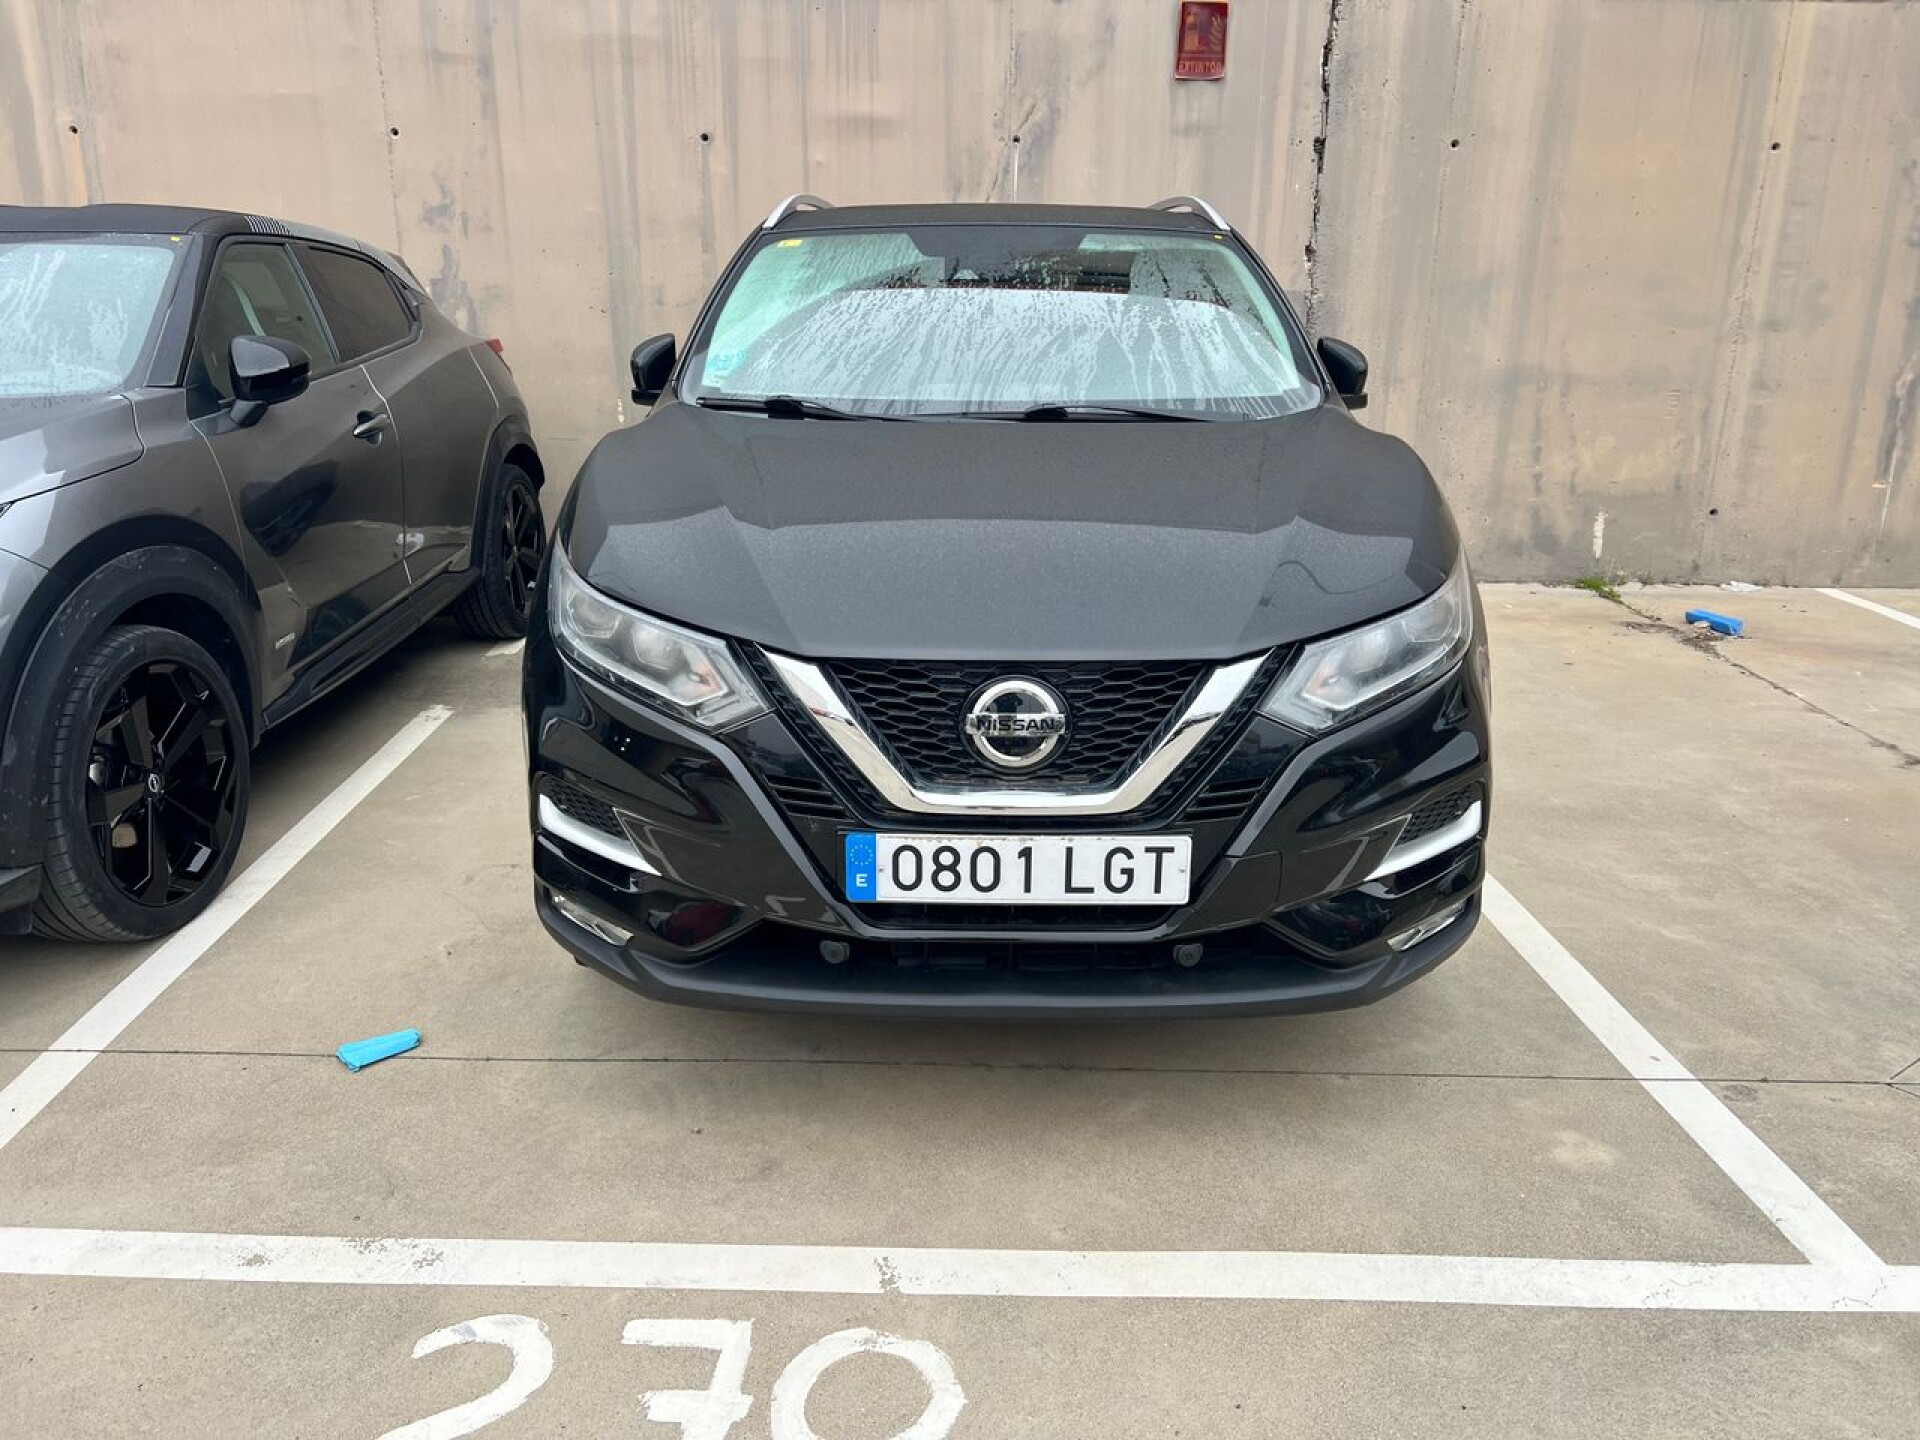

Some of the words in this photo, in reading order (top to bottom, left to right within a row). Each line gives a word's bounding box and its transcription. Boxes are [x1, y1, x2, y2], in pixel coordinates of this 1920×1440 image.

[976, 716, 1055, 731] NISSAN
[856, 873, 868, 888] E
[892, 845, 1033, 894] 0801
[1064, 846, 1175, 895] LGT
[374, 1313, 968, 1440] 270
